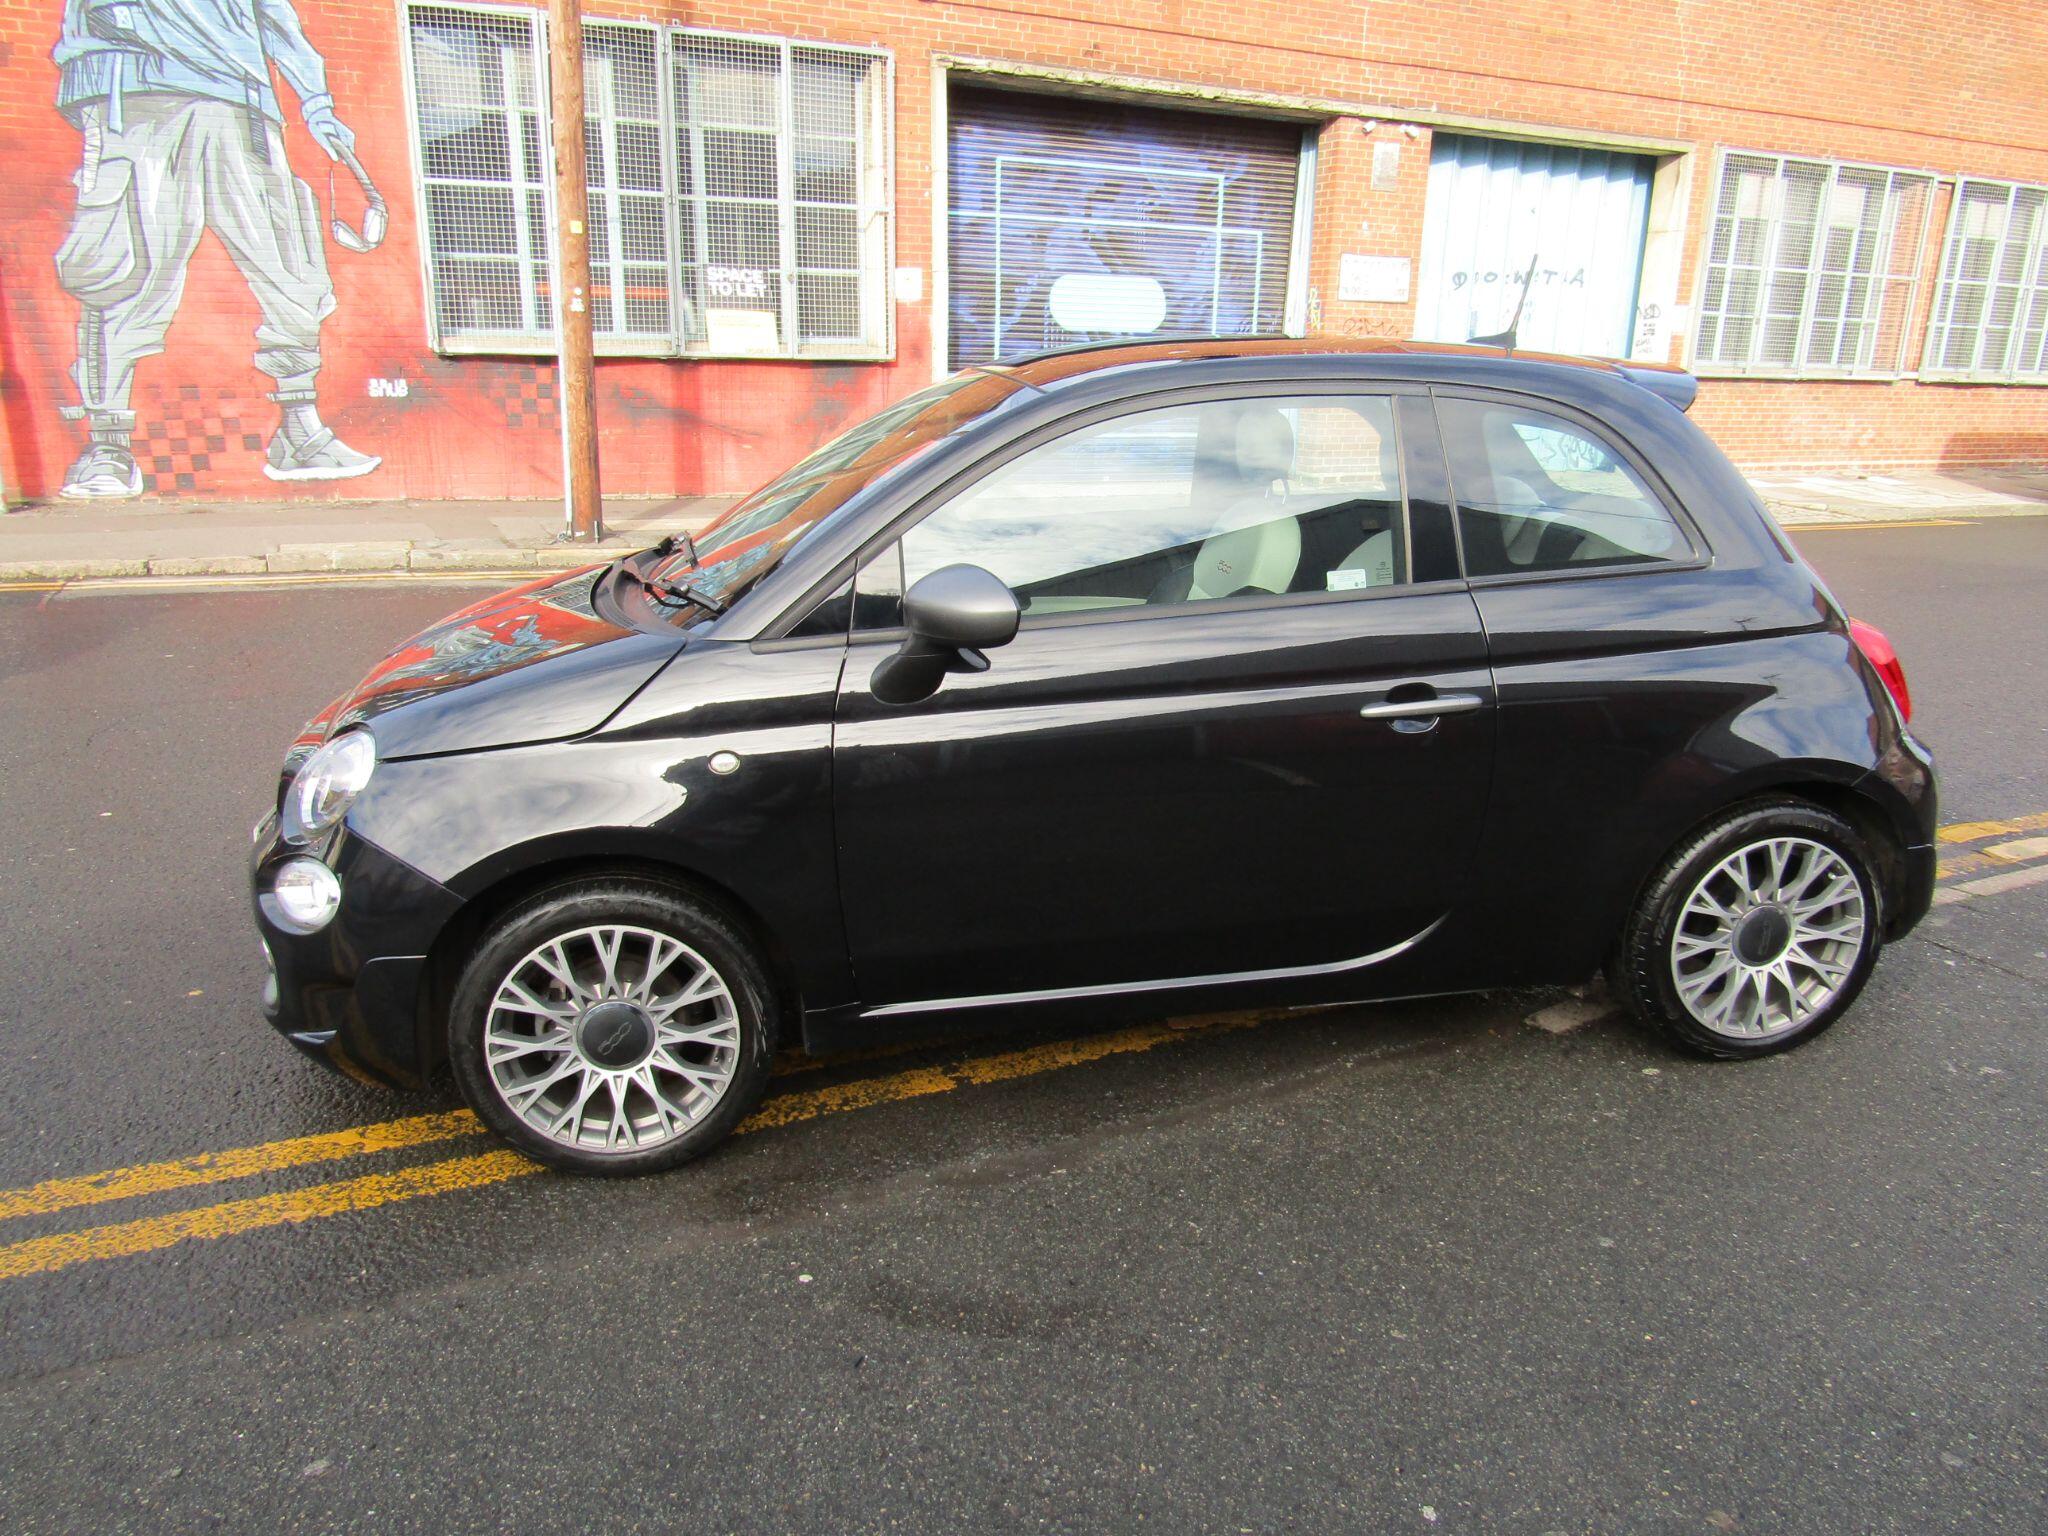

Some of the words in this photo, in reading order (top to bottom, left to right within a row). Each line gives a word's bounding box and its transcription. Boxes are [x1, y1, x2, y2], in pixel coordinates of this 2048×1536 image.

[707, 267, 764, 283] SPACE
[708, 282, 733, 296] TO
[736, 283, 766, 297] LET
